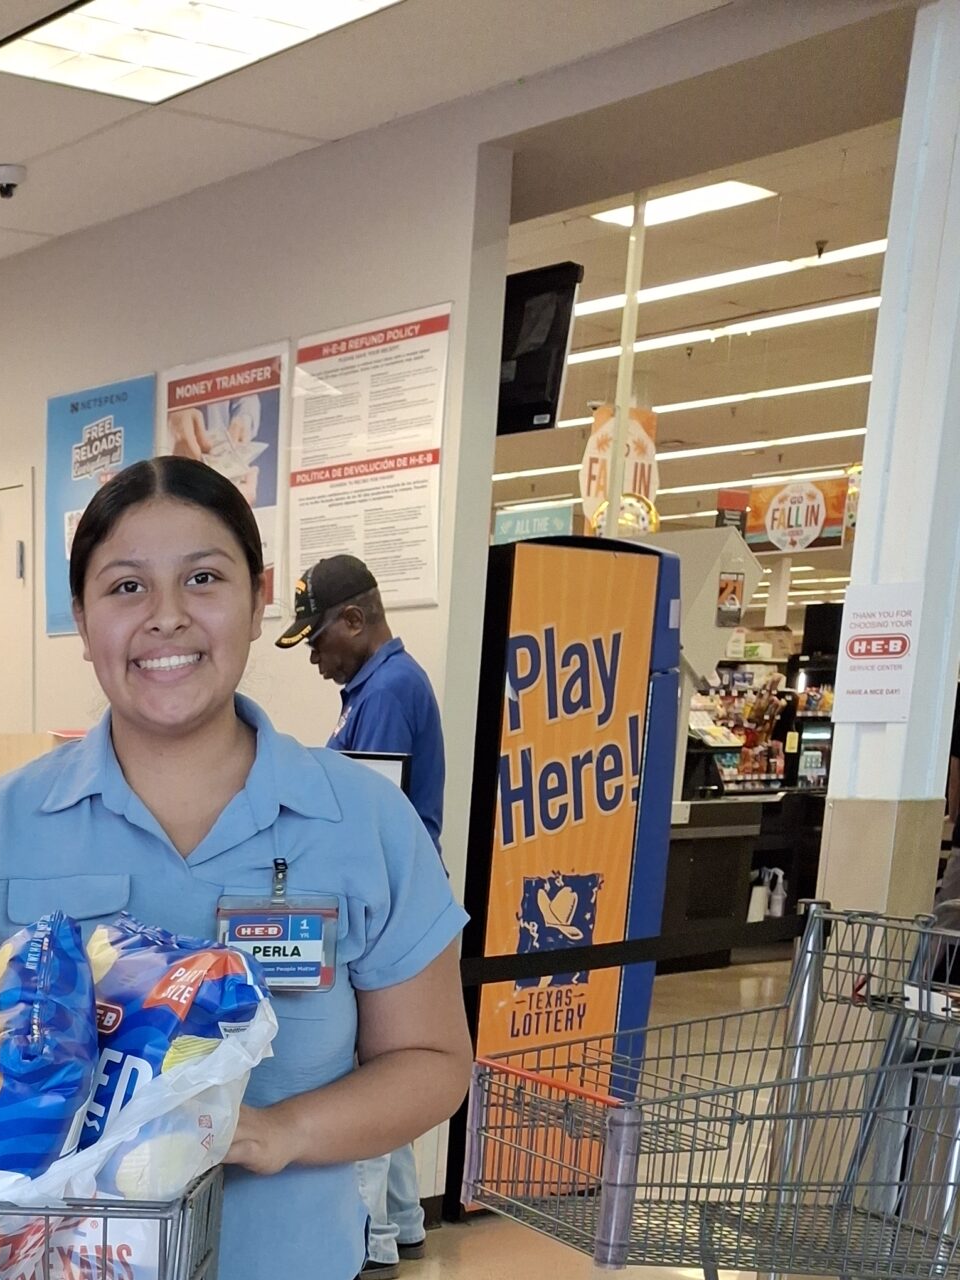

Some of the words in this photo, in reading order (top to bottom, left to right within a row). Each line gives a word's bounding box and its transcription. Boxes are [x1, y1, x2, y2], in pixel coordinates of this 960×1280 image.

[348, 333, 385, 349] REFUND
[386, 324, 421, 341] POLICY
[175, 377, 214, 400] MONEY
[215, 366, 272, 391] TRANSFER
[85, 420, 112, 440] FREE
[74, 431, 122, 462] RELOADS
[332, 467, 343, 478] DE
[343, 459, 396, 476] DEVOLUCIÓN
[396, 457, 408, 467] DE
[515, 519, 531, 534] ALL
[533, 517, 550, 532] THE
[771, 506, 803, 530] FALL
[804, 504, 820, 527] IN
[849, 621, 889, 629] CHOOSING
[890, 620, 912, 628] YOUR
[852, 611, 876, 619] THANK
[878, 610, 895, 618] YOU
[896, 610, 912, 618] FOR
[507, 628, 622, 731] Play
[500, 714, 640, 847] Here!
[300, 919, 309, 929] 1
[252, 946, 301, 957] PERLA
[528, 989, 573, 1010] TEXAS
[510, 1003, 587, 1038] LOTTERY
